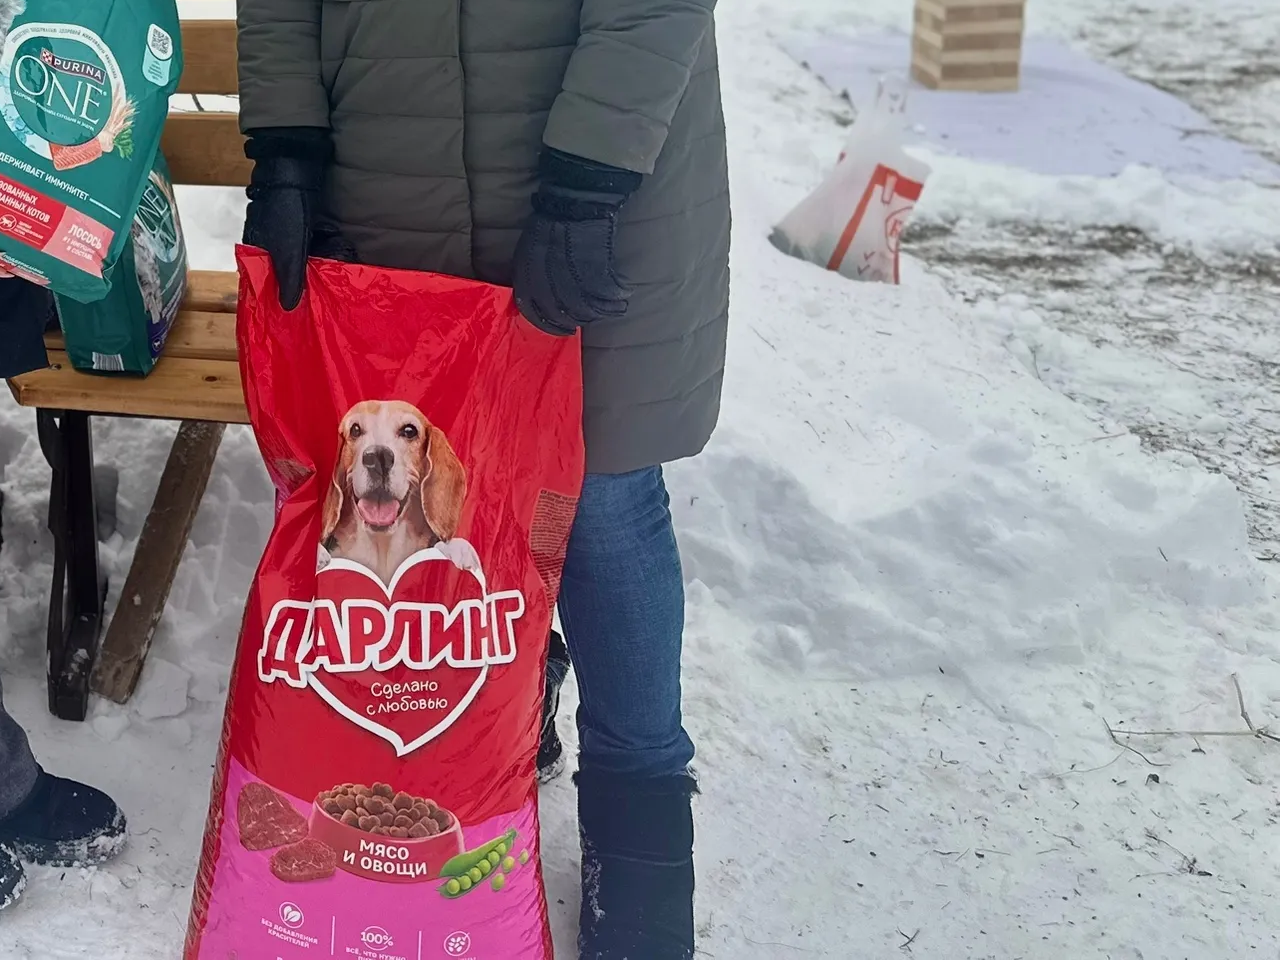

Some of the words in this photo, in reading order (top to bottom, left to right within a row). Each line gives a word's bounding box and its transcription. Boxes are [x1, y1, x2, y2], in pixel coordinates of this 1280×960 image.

[53, 57, 103, 80] PURINA
[15, 54, 104, 126] ONE
[45, 173, 90, 201] ИММУНИТЕТ
[25, 206, 51, 224] КОТОВ
[67, 224, 103, 250] ЛОСОСЬ
[257, 590, 525, 689] ДАРЛИНГ
[370, 679, 439, 699] Сделано
[366, 703, 376, 716] с
[378, 695, 449, 714] любовью
[359, 839, 410, 861] МЯСО
[343, 850, 356, 866] И
[360, 858, 428, 878] ОВОЩИ
[261, 918, 273, 928] БЕЗ
[273, 923, 318, 945] ДОБАВЛЕНИЯ
[267, 928, 310, 949] КРАСИТЕЛЕЙ
[360, 930, 395, 948] 100%
